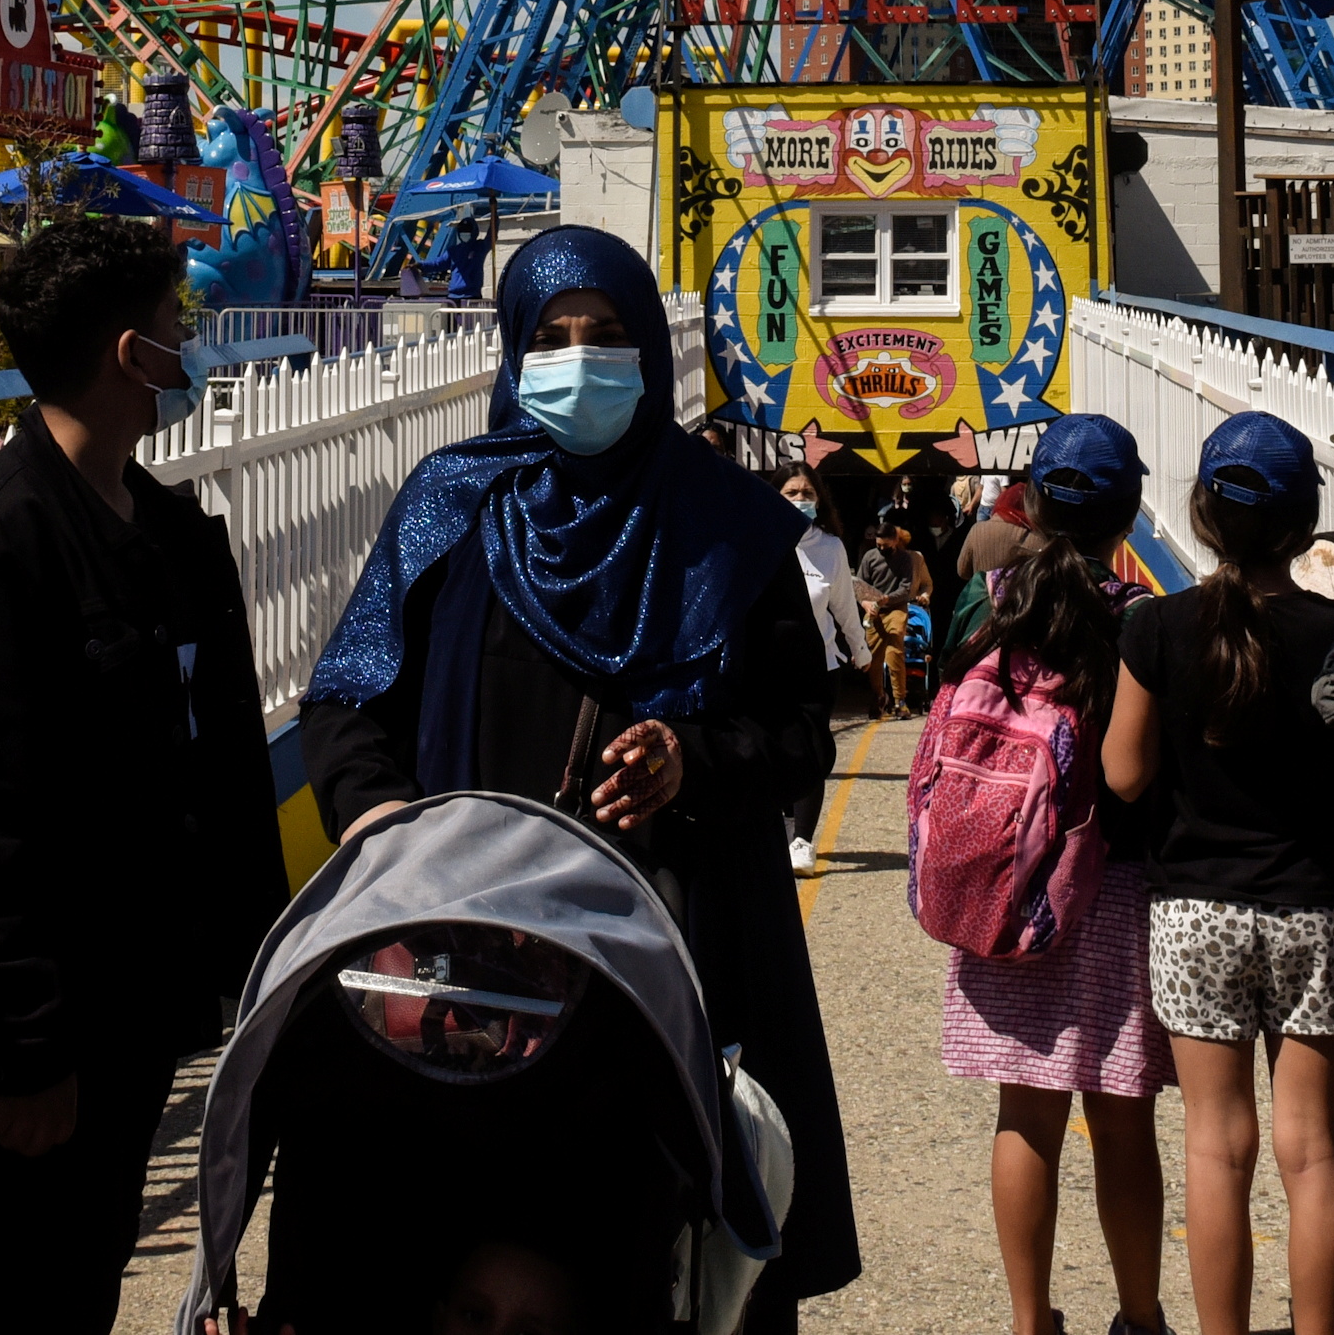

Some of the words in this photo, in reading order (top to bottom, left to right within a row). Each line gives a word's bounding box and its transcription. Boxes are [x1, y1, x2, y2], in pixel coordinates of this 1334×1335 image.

[9, 60, 88, 121] STATION
[765, 137, 831, 169] MORE
[929, 137, 997, 170] RIDES
[767, 244, 788, 342] FUN
[977, 231, 1002, 347] GAMES
[835, 334, 938, 354] EXCITEMENT
[847, 372, 922, 398] THRILLS
[974, 421, 1049, 471] WA
